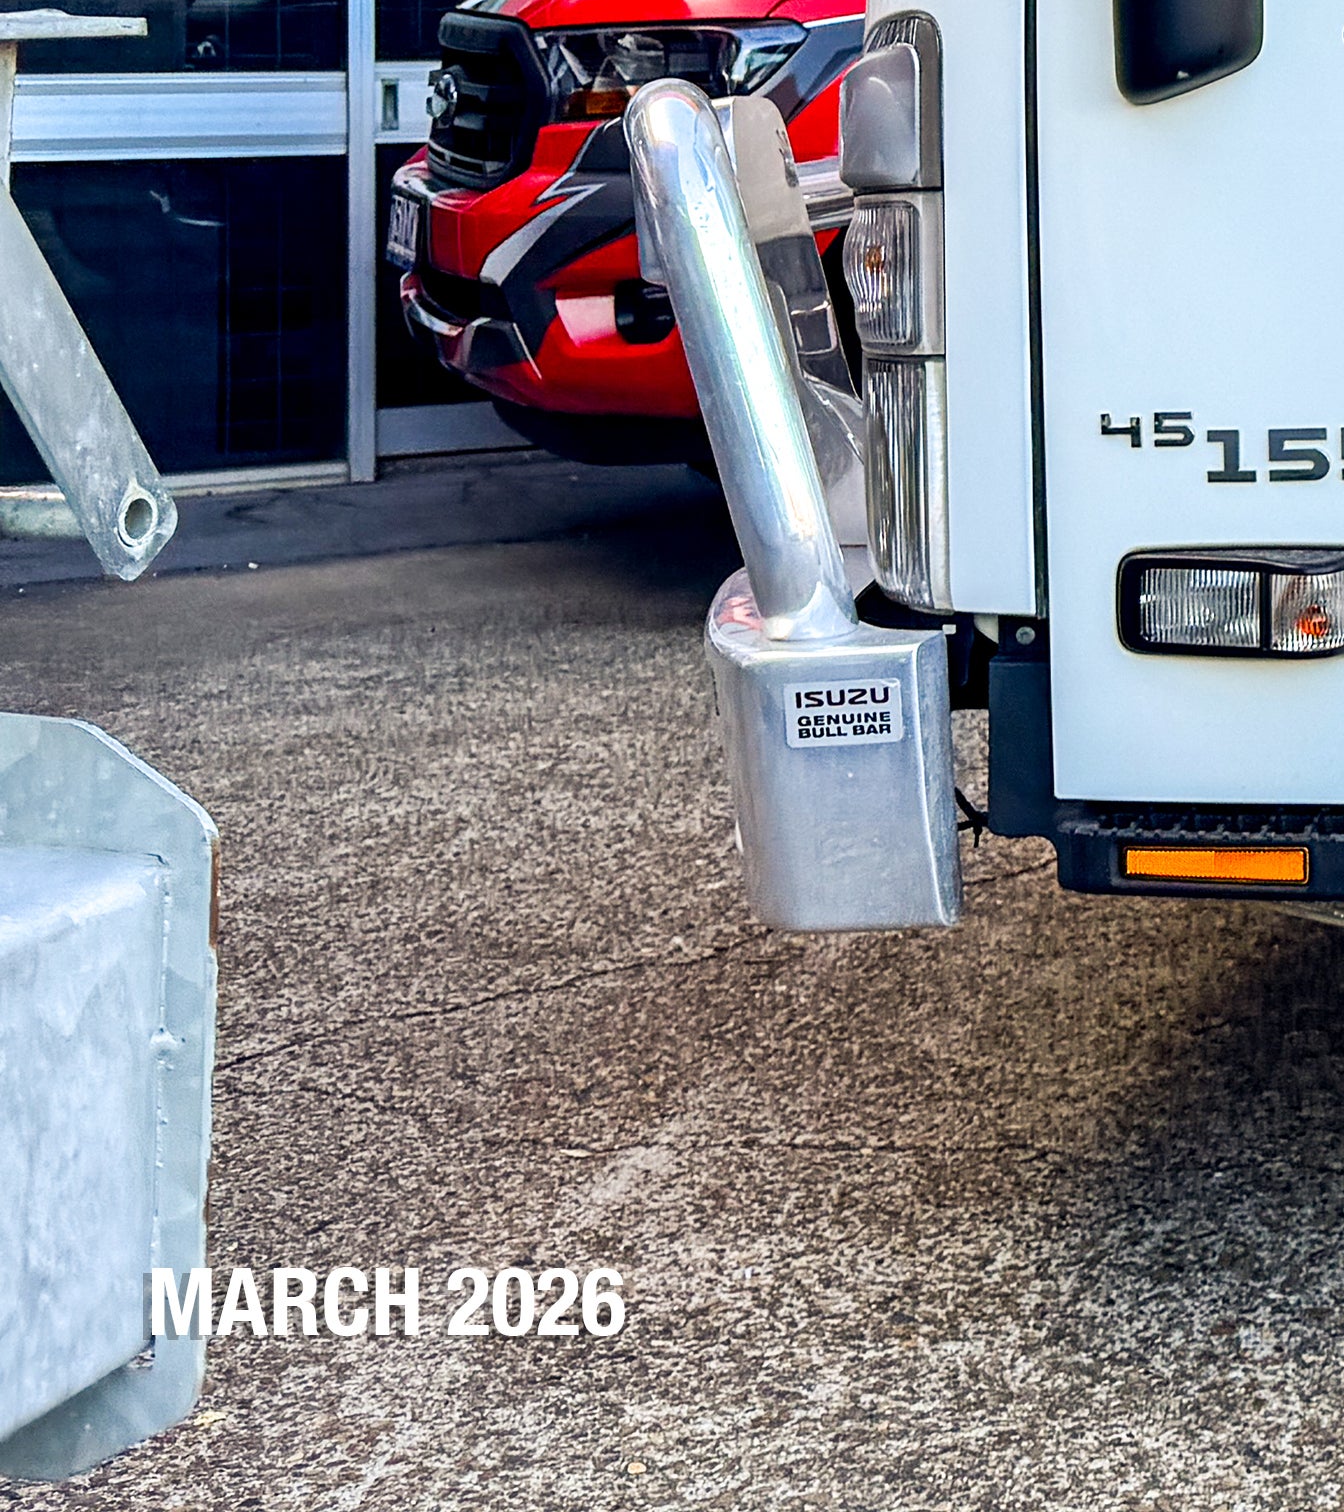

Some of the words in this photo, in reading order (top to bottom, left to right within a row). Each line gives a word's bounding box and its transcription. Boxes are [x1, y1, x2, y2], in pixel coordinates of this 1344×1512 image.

[1100, 412, 1195, 448] 45
[795, 686, 890, 708] ISUZU
[797, 711, 891, 727] GENUINE
[798, 726, 848, 739] BULL
[852, 724, 892, 735] BAR
